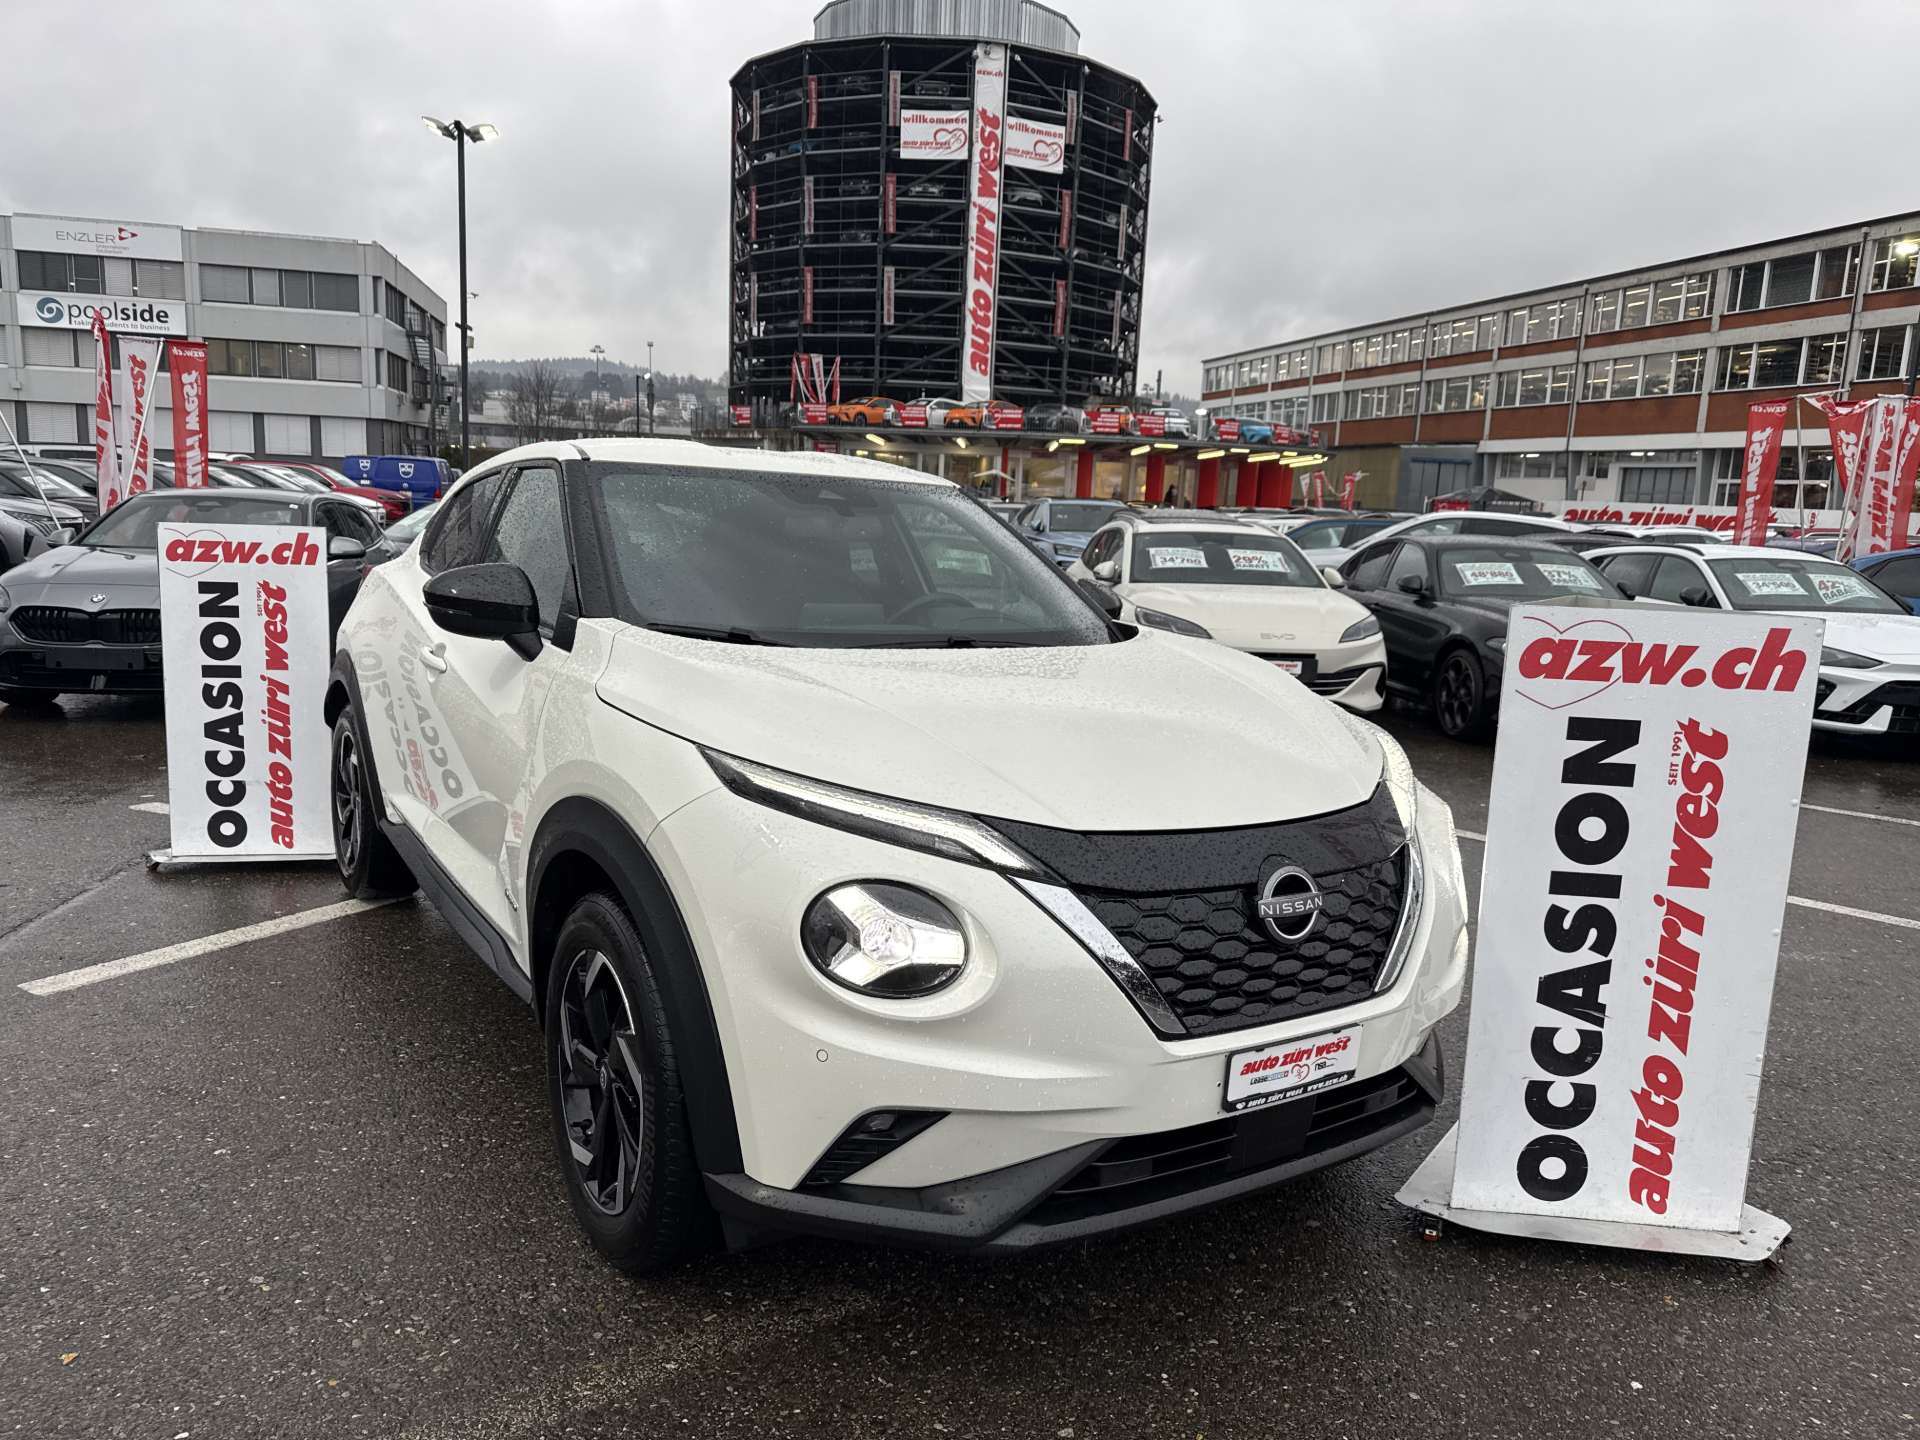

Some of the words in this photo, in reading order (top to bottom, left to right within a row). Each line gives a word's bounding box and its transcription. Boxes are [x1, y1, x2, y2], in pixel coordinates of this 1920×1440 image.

[902, 113, 968, 125] willkommen
[1007, 122, 1064, 140] willkommen
[977, 106, 1001, 198] west
[56, 230, 116, 244] ENZLER
[970, 201, 997, 290] züri
[67, 301, 170, 325] poolside
[139, 322, 170, 332] business
[969, 288, 993, 377] auto
[1563, 504, 1623, 522] auto
[1867, 476, 1890, 542] züri
[165, 532, 320, 566] azw.ch
[257, 579, 290, 672] west
[1518, 628, 1807, 692] azw.ch
[198, 581, 248, 848] OCCASION
[260, 674, 293, 761] züri
[1672, 731, 1683, 757] 1991
[261, 760, 295, 849] auto
[1667, 717, 1729, 890] west
[1668, 762, 1680, 786] SEIT
[1260, 895, 1323, 916] NISSAN
[1516, 716, 1642, 1202] OCCASION
[1642, 893, 1705, 1057] züri
[1240, 1055, 1280, 1076] auto
[1279, 1045, 1315, 1067] züri
[1315, 1035, 1351, 1058] west
[1247, 1097, 1266, 1108] auto
[1267, 1090, 1285, 1103] züri
[1285, 1086, 1304, 1098] west
[1629, 1054, 1684, 1215] auto
